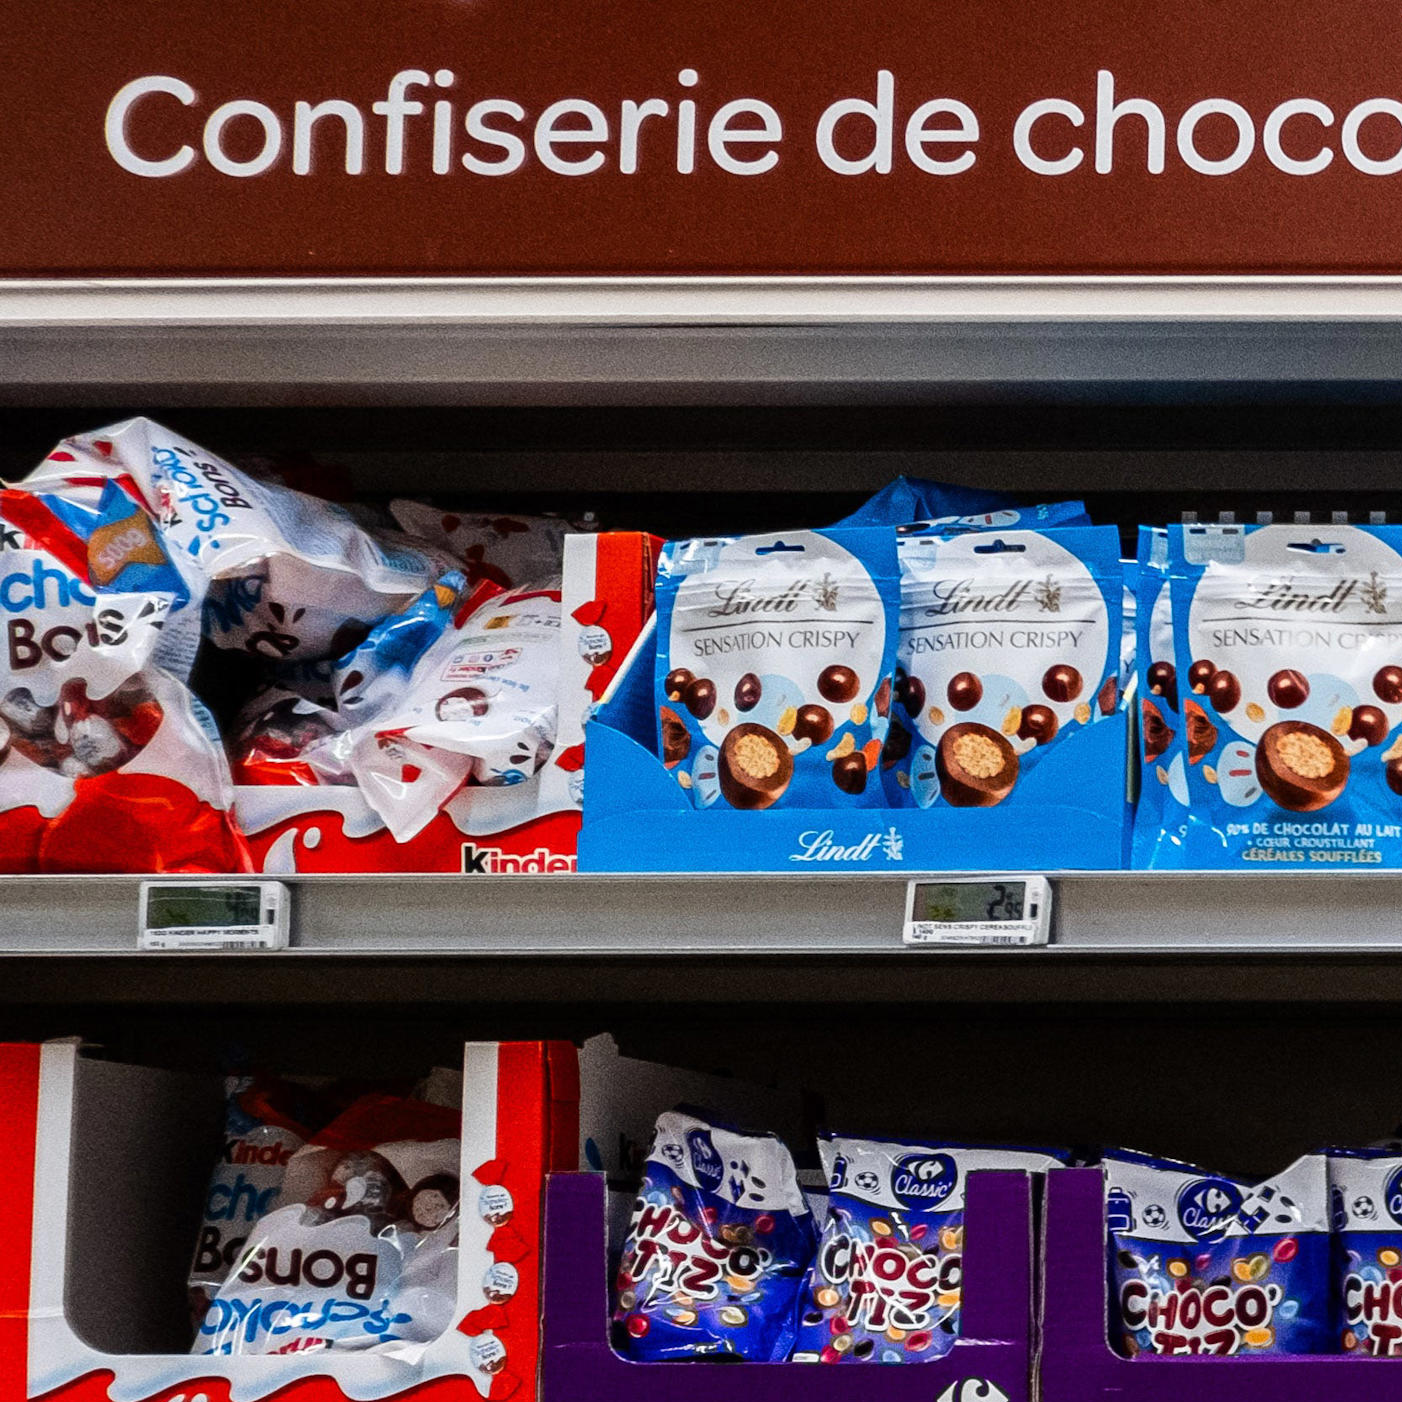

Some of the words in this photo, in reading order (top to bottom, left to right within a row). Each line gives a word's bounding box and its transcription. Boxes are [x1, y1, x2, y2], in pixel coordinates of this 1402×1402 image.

[104, 68, 782, 178] Confiserie
[814, 68, 981, 178] de
[707, 579, 800, 618] Lindt
[927, 577, 1021, 618] Lindt
[693, 630, 782, 658] SENSATION
[788, 629, 862, 653] CRISPY
[906, 631, 1005, 657] SENSATION
[1009, 629, 1083, 653] CRISPY
[1212, 628, 1332, 650] SENSATION
[1253, 822, 1269, 838] DE
[1273, 822, 1350, 839] CHOCOLAT
[1353, 823, 1372, 838] AU
[1374, 823, 1402, 838] LAIT
[790, 830, 883, 864] Lindt
[894, 1174, 949, 1199] Classic
[238, 1249, 379, 1301] Bons
